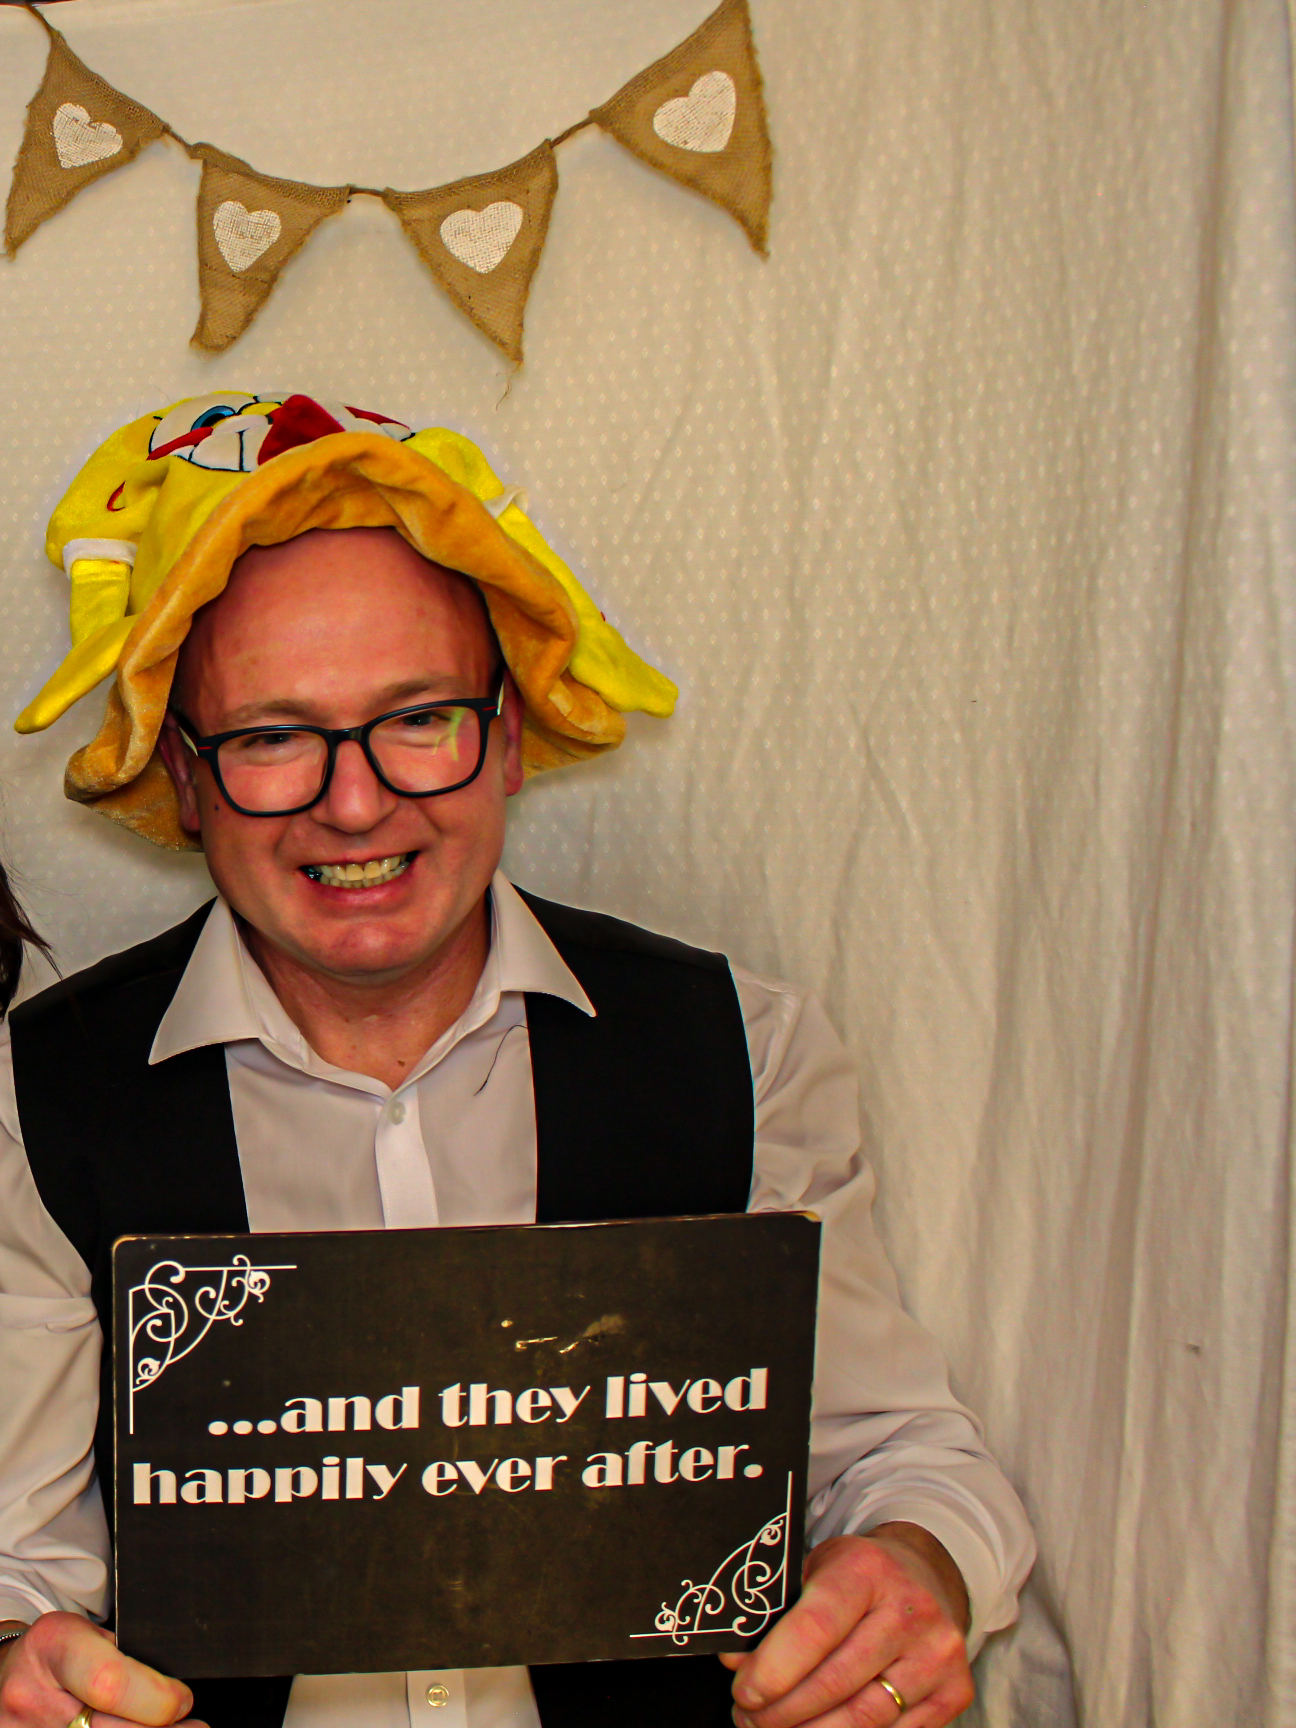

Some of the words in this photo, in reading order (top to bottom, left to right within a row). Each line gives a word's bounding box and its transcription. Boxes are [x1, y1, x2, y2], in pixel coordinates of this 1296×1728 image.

[208, 1386, 421, 1435] ...and
[437, 1382, 591, 1428] they
[605, 1368, 769, 1419] lived
[132, 1456, 408, 1505] happily
[421, 1454, 569, 1497] ever
[581, 1440, 764, 1489] after.
